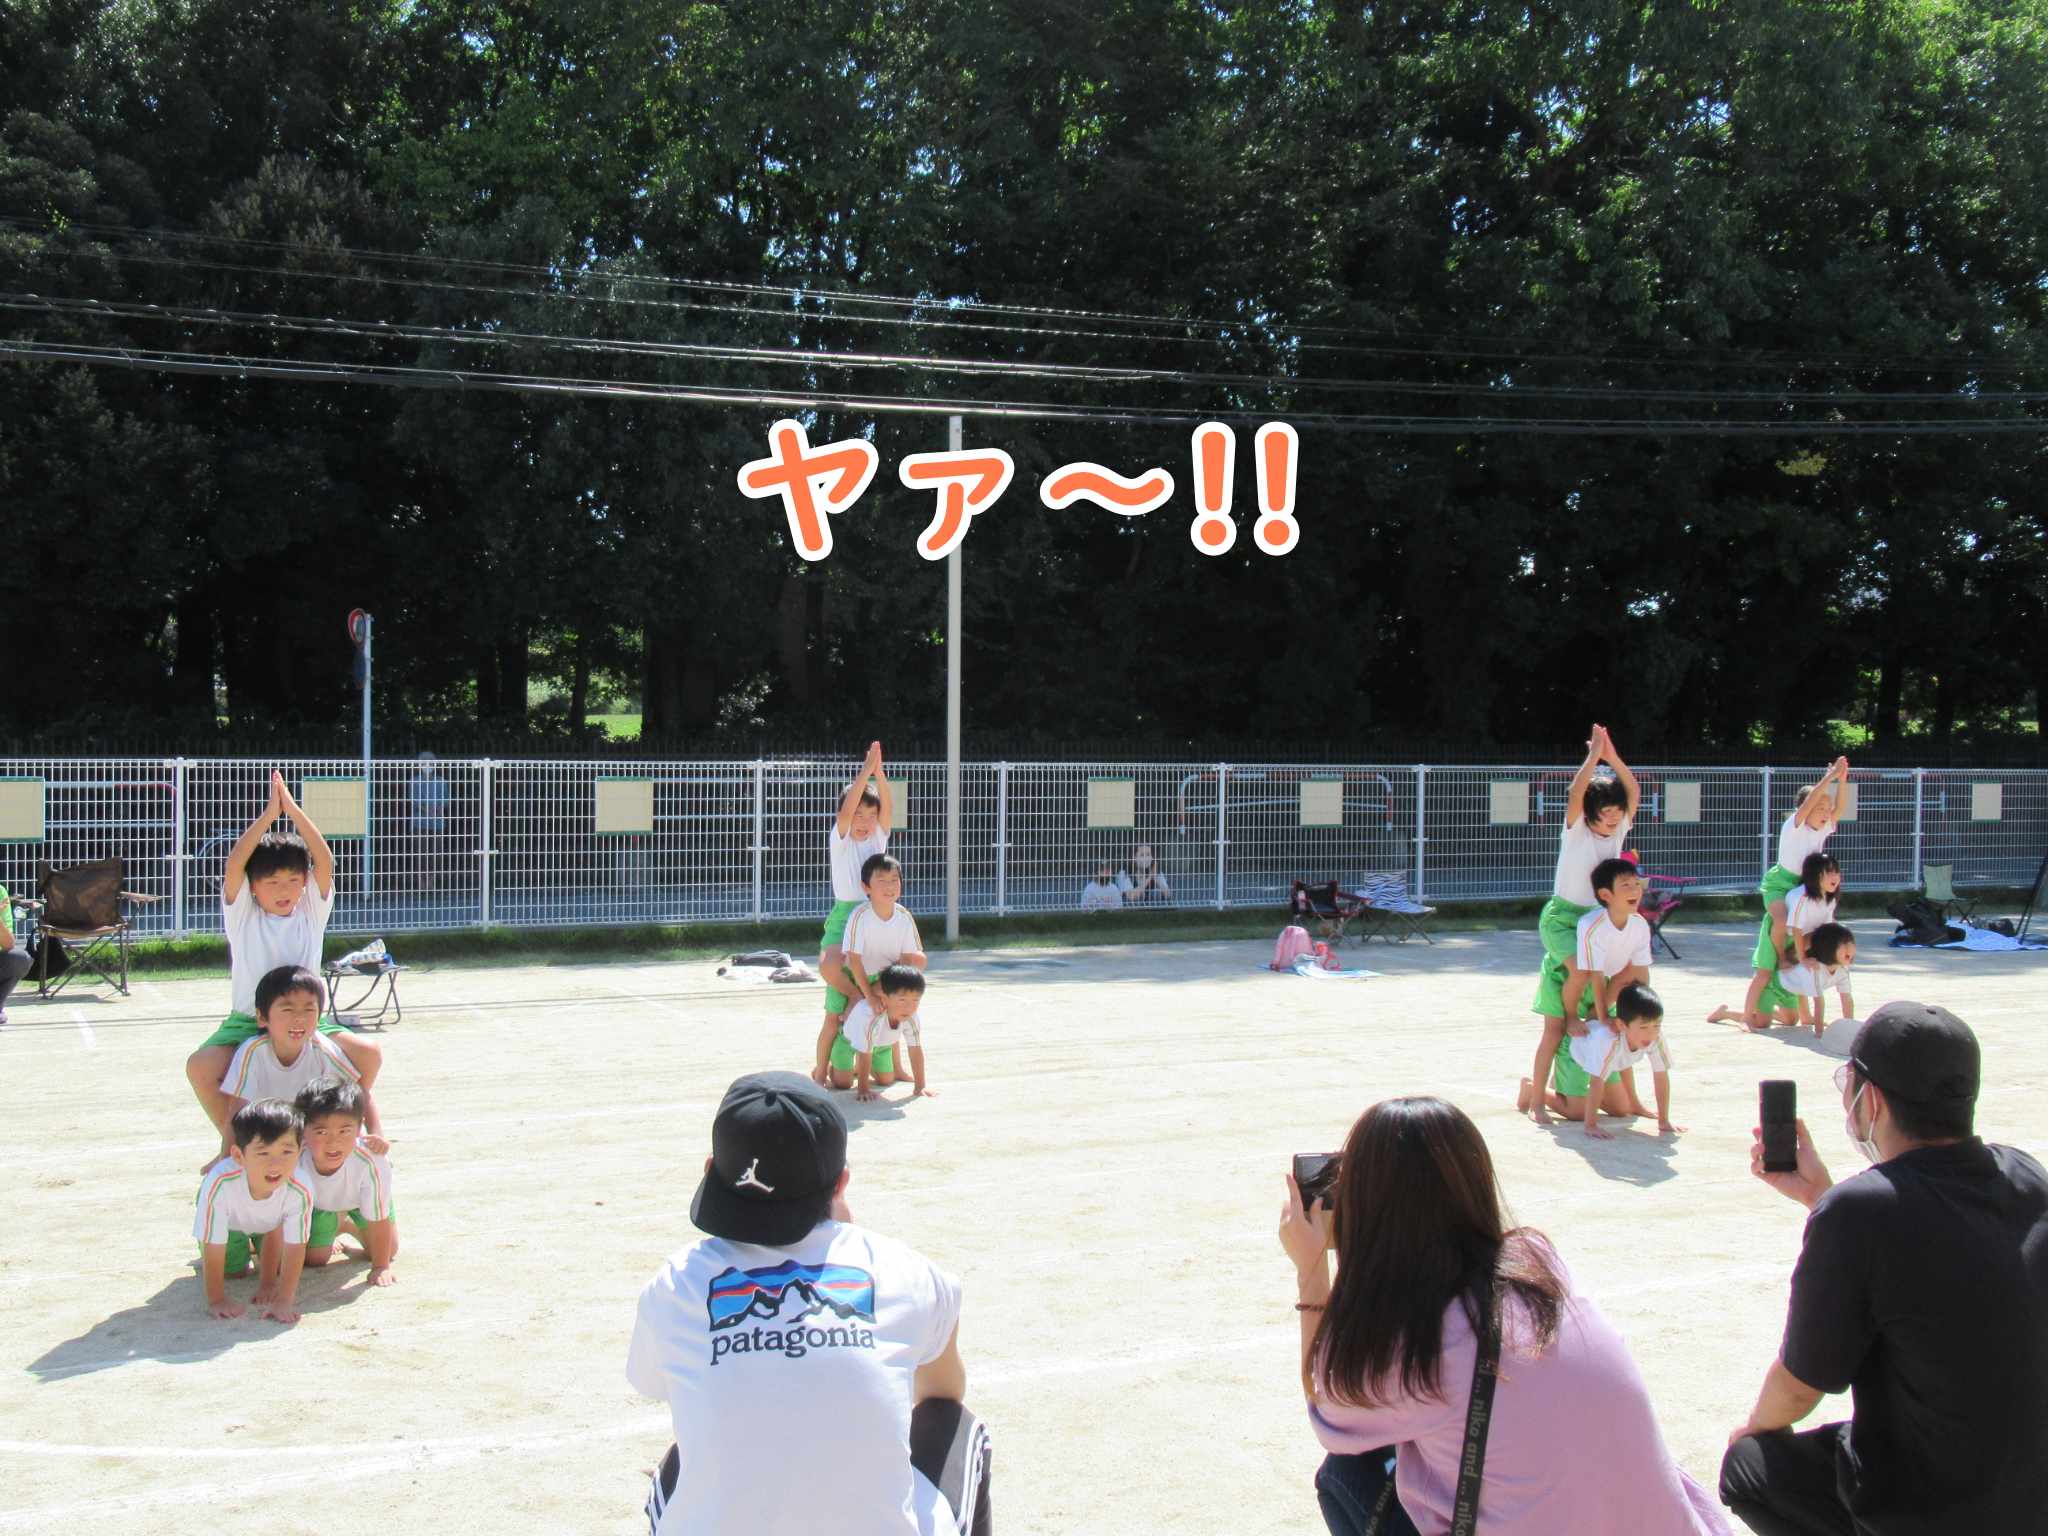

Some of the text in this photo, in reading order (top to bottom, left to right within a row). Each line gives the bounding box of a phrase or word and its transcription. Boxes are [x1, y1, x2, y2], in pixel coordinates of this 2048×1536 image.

[710, 1322, 877, 1366] patagonia
[1469, 1398, 1489, 1437] niko
[1463, 1442, 1479, 1478] and
